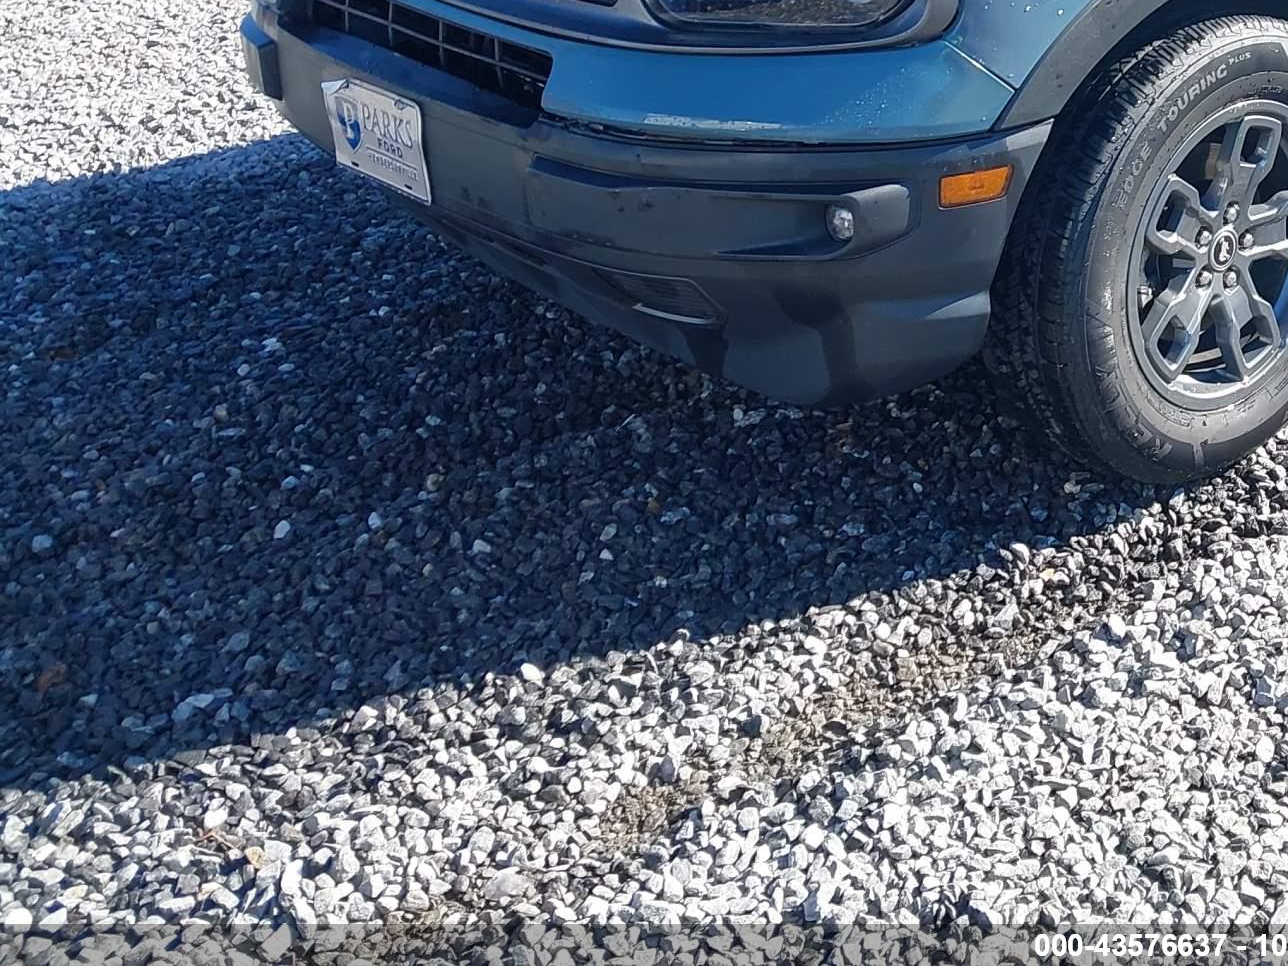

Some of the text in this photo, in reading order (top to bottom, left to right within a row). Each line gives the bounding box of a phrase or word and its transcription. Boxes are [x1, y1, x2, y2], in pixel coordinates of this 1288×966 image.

[1157, 63, 1229, 132] TOURING
[1228, 51, 1252, 66] PLUS
[360, 103, 414, 149] PARKS
[377, 137, 404, 159] FORD
